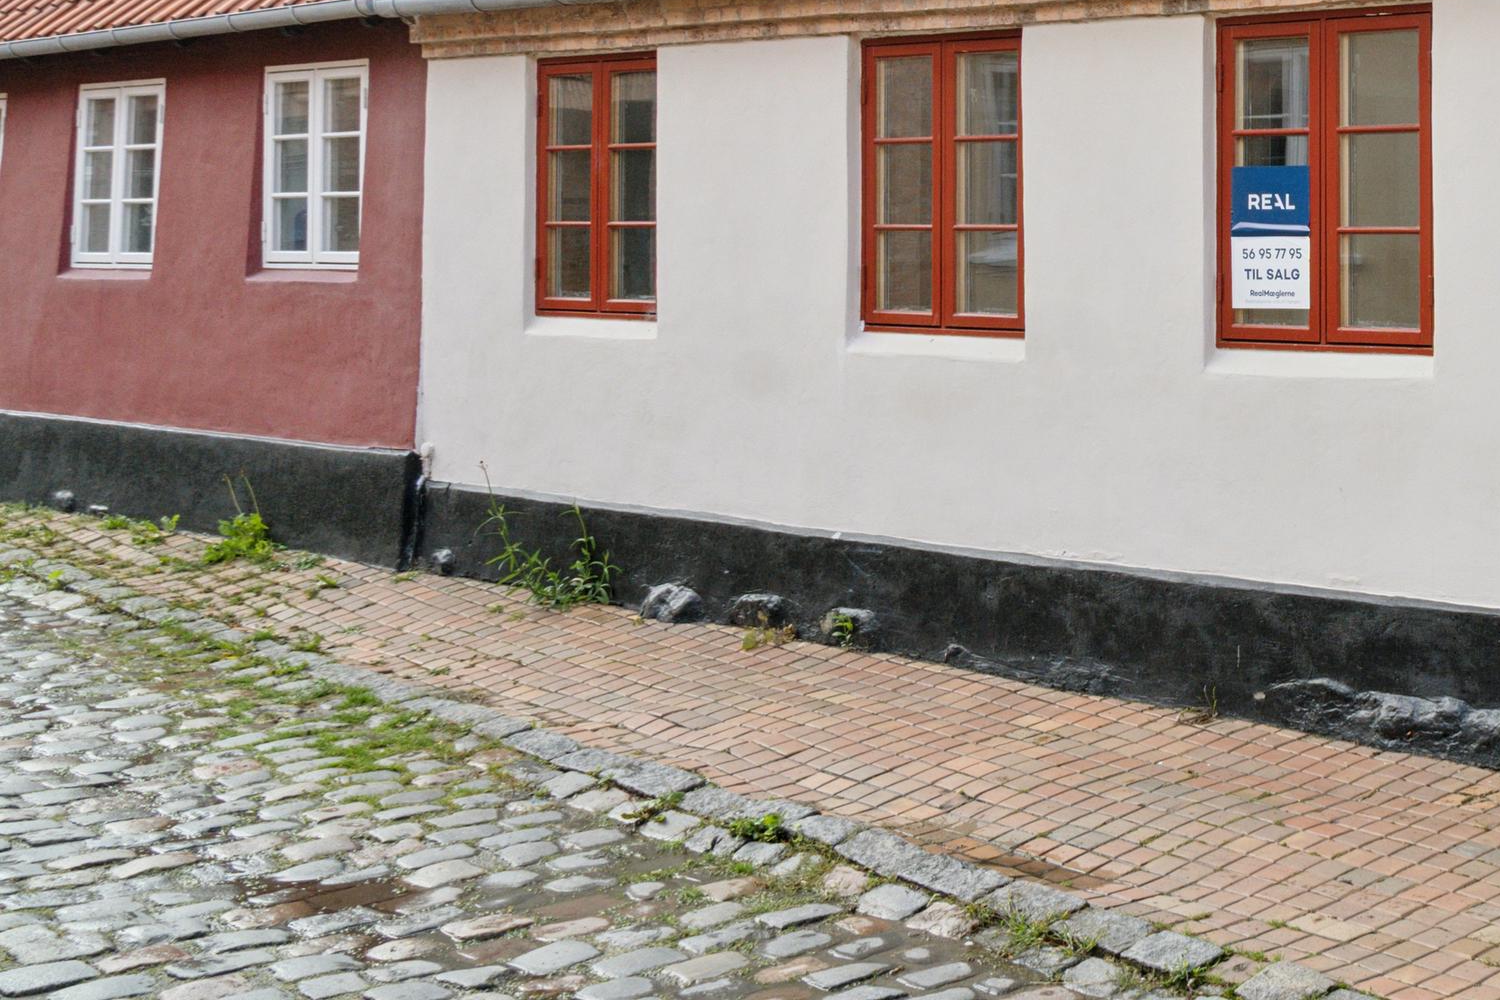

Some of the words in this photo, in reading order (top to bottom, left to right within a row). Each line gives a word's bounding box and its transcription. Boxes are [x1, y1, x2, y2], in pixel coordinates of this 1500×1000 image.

[1248, 193, 1296, 210] REAL
[1242, 248, 1256, 260] 56
[1259, 248, 1272, 260] 95
[1275, 248, 1287, 260] 77
[1289, 248, 1302, 260] 95
[1244, 269, 1263, 281] TIL
[1266, 269, 1300, 281] SALG
[1249, 289, 1295, 299] RealMæglerne
